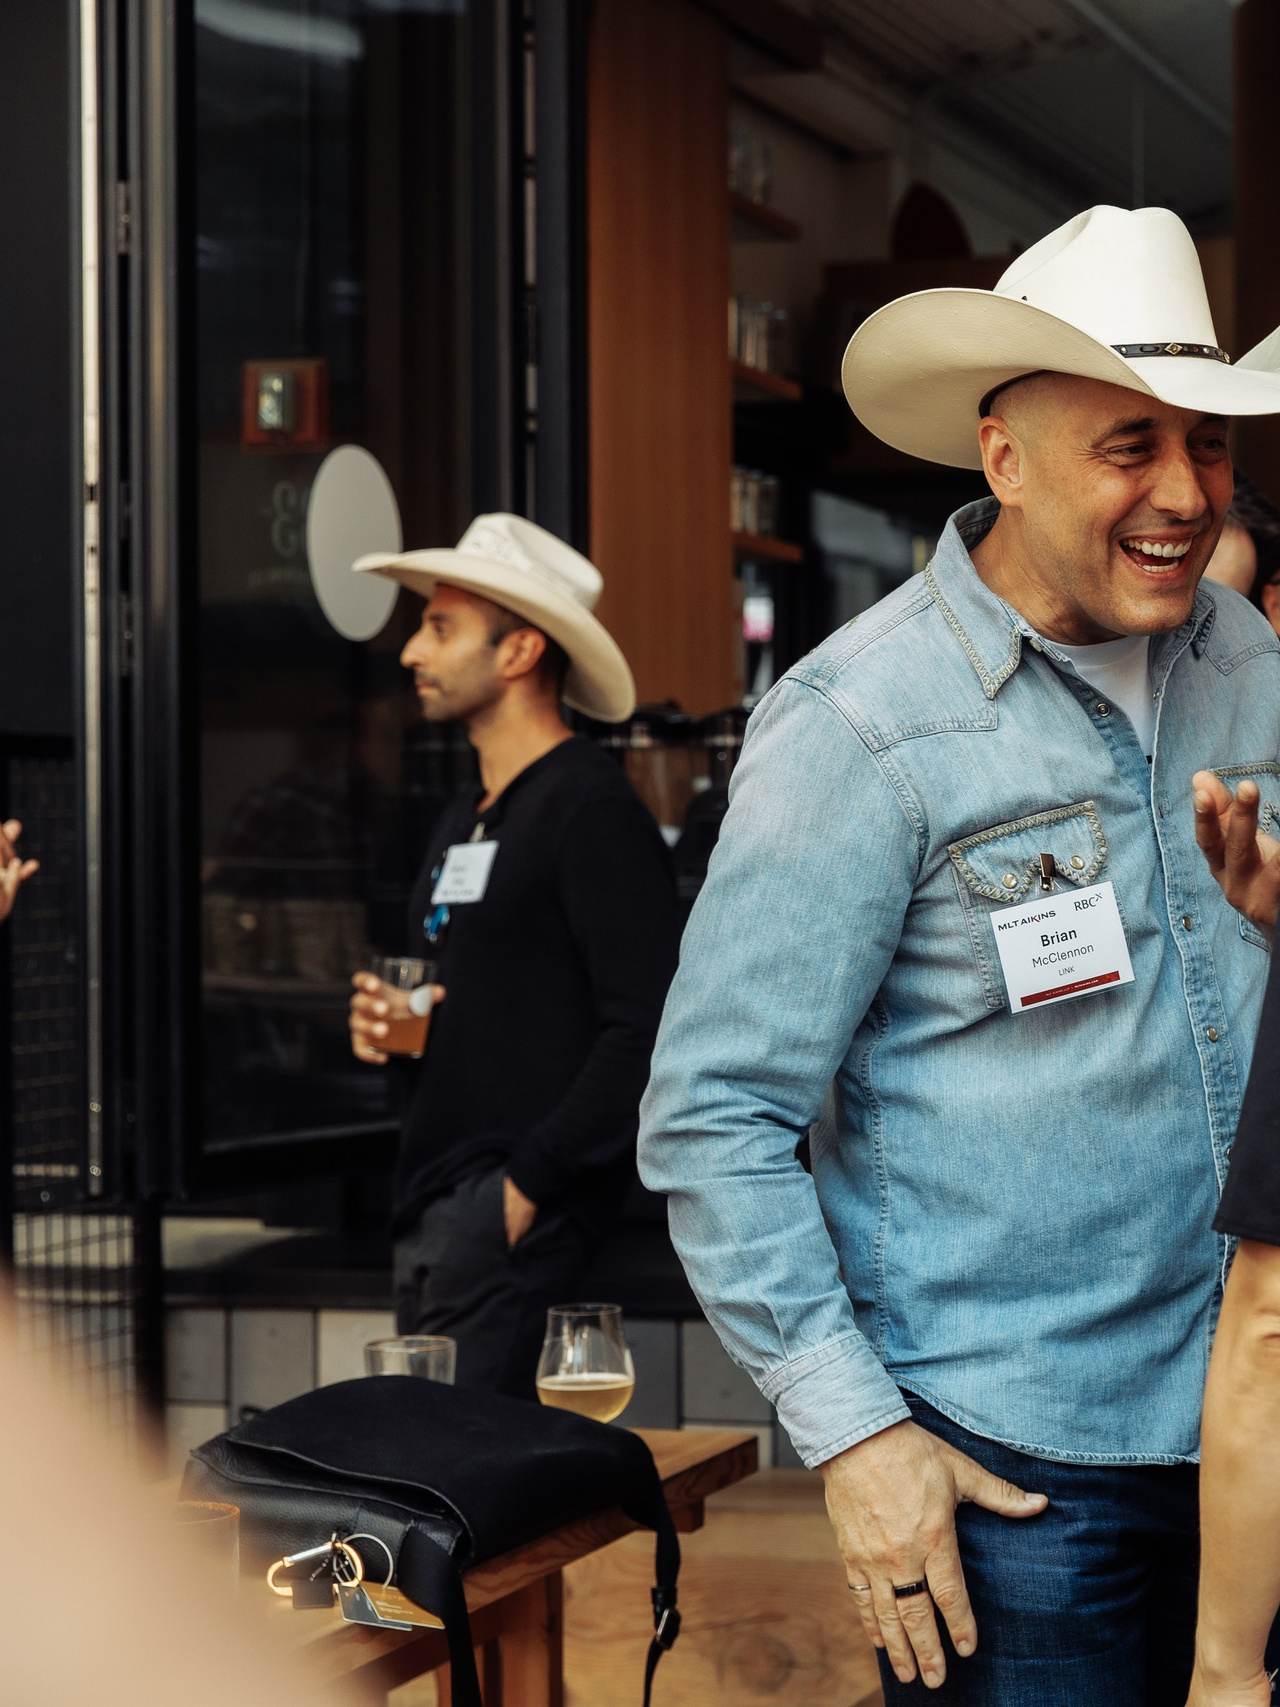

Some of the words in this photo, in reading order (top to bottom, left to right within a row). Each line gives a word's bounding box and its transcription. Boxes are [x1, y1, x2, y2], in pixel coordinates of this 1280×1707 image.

[998, 920, 1019, 931] MLT
[1021, 910, 1057, 925] AIKINS
[1040, 929, 1077, 947] Brian
[1032, 944, 1095, 968] McClennon
[1058, 966, 1075, 976] LINK
